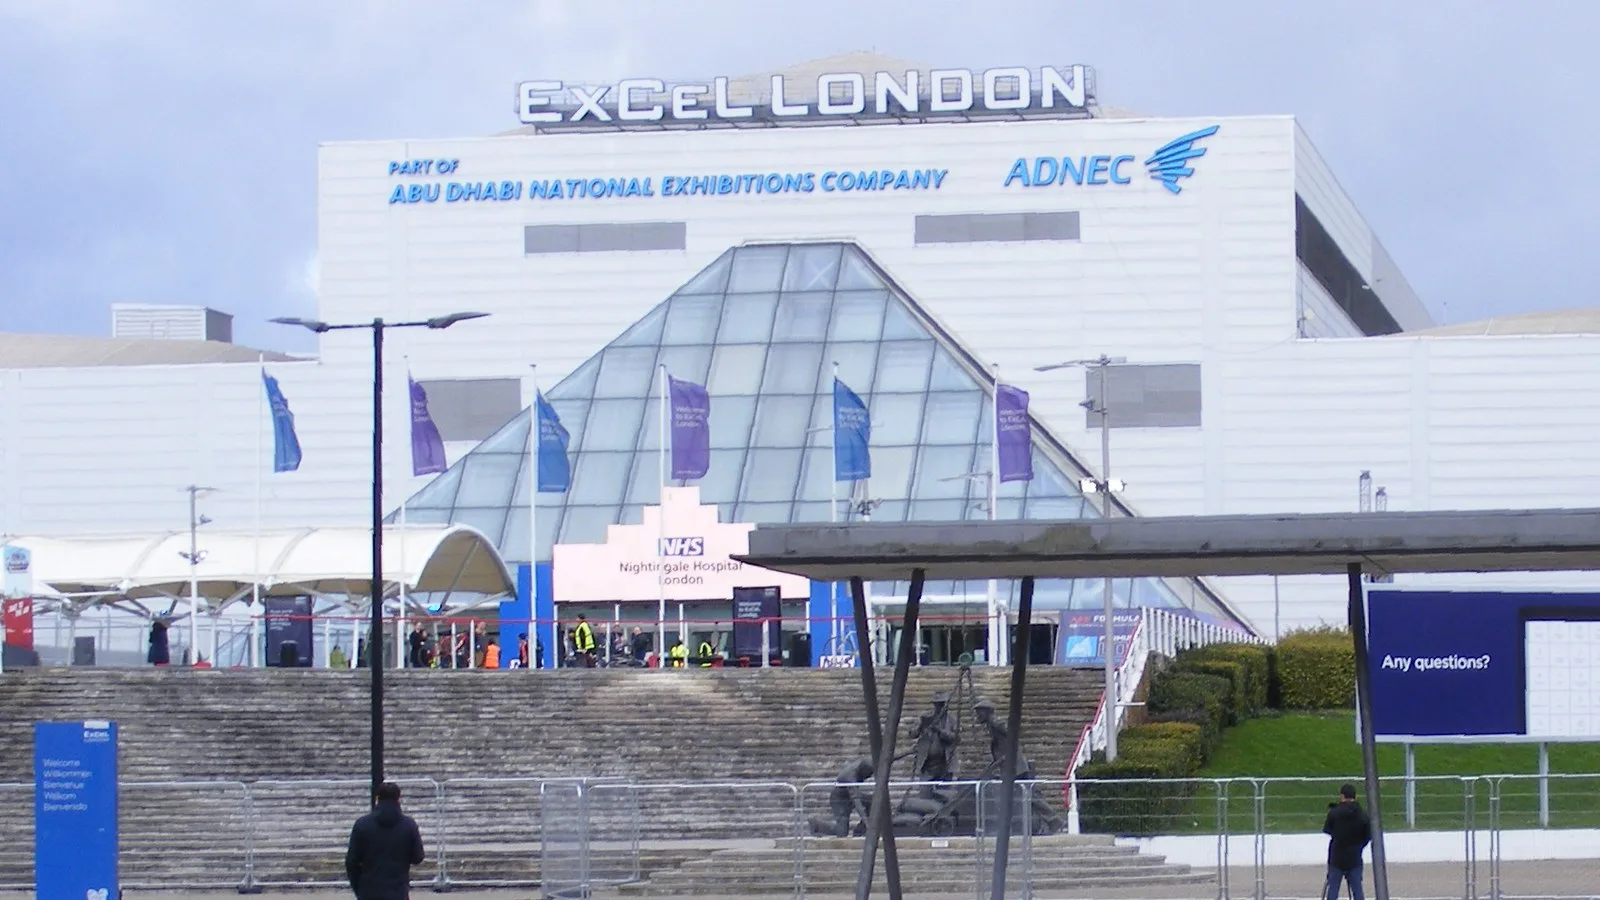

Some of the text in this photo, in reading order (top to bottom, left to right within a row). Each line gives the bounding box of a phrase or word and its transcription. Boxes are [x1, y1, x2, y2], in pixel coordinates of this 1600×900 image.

[771, 64, 1086, 116] LONDON
[388, 159, 460, 175] PART OF
[1004, 154, 1136, 187] ADNEC
[389, 168, 949, 204] ABU DHABI NATIONAL EXHIBITIONS COMPANY
[661, 537, 703, 556] NHS
[693, 559, 743, 573] Hospital
[1093, 614, 1141, 623] FOMULA
[1382, 655, 1490, 672] Any questions?
